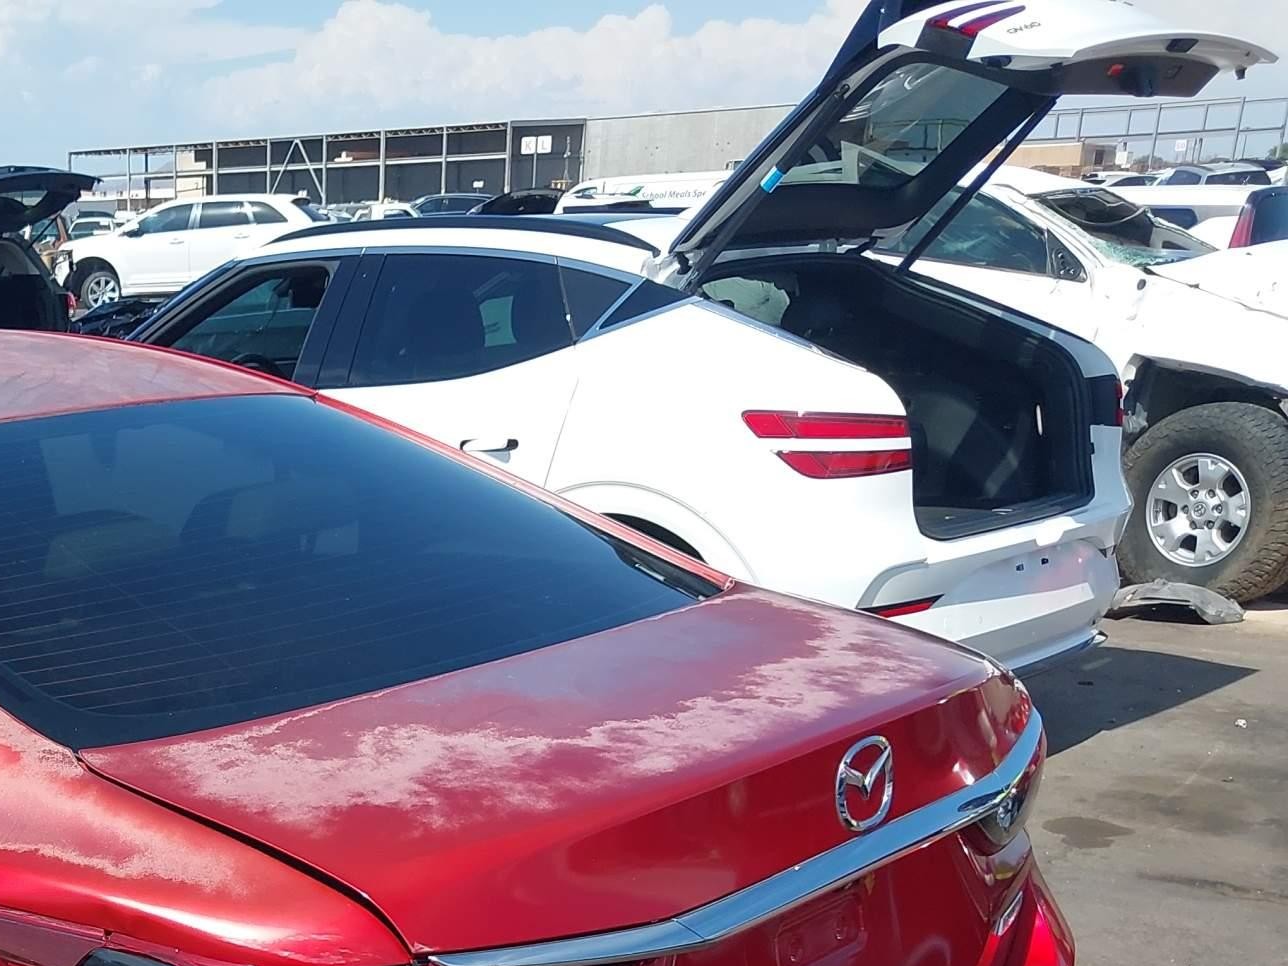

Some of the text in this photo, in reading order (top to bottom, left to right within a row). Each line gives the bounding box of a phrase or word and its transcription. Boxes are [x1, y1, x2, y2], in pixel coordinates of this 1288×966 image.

[541, 140, 548, 151] L
[642, 191, 668, 200] School
[668, 190, 691, 199] Meals
